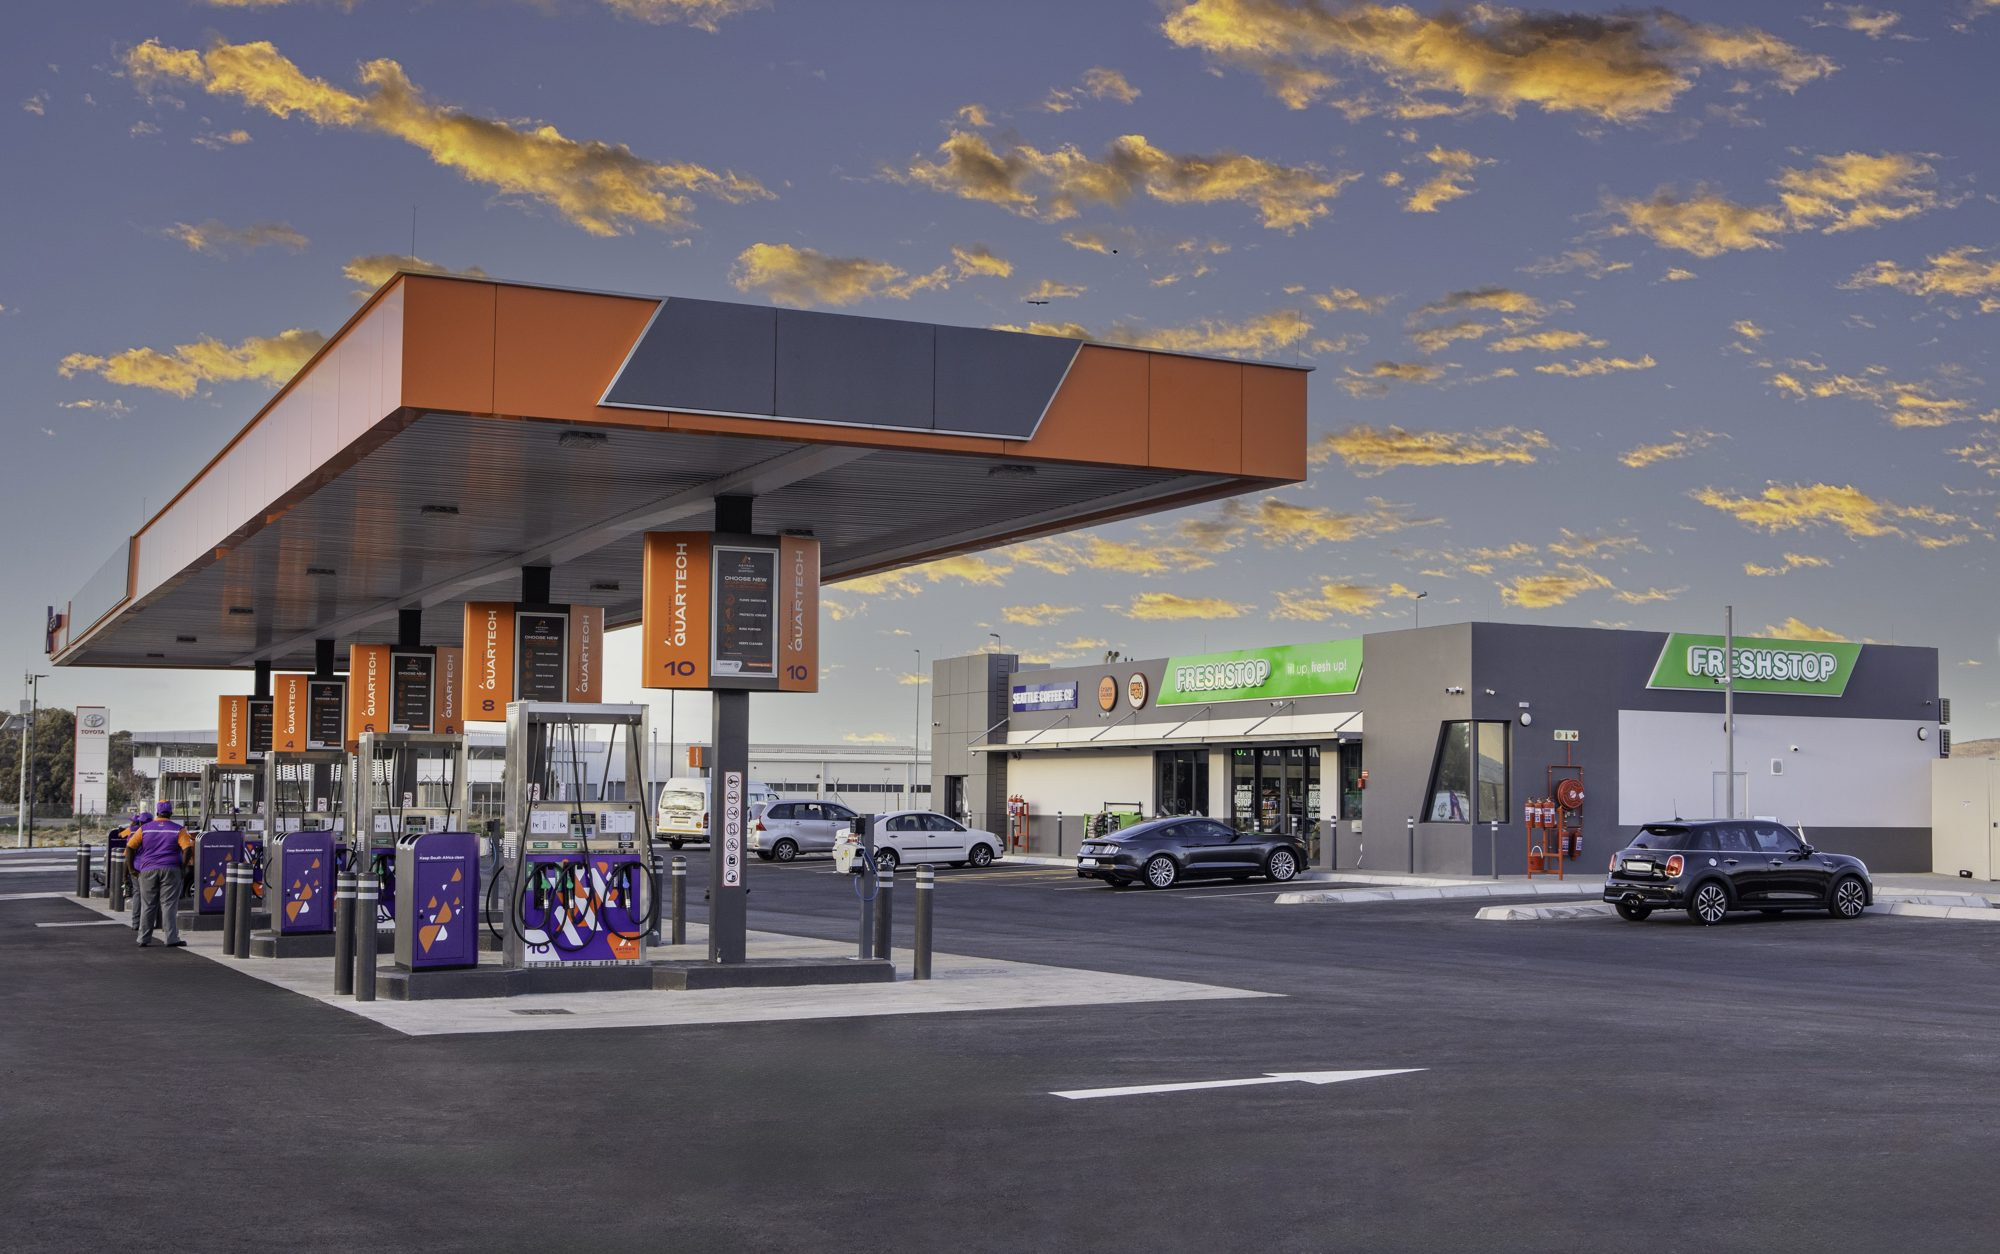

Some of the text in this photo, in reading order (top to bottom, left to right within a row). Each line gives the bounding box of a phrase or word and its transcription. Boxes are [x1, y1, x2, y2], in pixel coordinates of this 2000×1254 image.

[674, 543, 687, 647] QUARTECH
[794, 550, 804, 652] QUARTECH
[486, 610, 497, 690] QUARTECH
[581, 615, 590, 693] QUARTECH
[664, 661, 696, 676] 10
[786, 665, 808, 681] 10
[1175, 659, 1271, 692] FRESHSTOP
[1311, 661, 1331, 673] fresh
[1333, 659, 1347, 672] up!
[1687, 645, 1838, 682] FRESHSTOP
[367, 651, 377, 716] QUARTECH
[446, 654, 455, 719] QUARTECH
[288, 680, 296, 735] QUARTECH
[482, 699, 495, 712] 8
[1012, 690, 1040, 705] SEATTLE
[1040, 689, 1064, 703] COFFEE
[229, 752, 237, 760] 2
[284, 740, 294, 749] 4
[1235, 799, 1252, 807] STOP
[526, 943, 550, 955] 10
